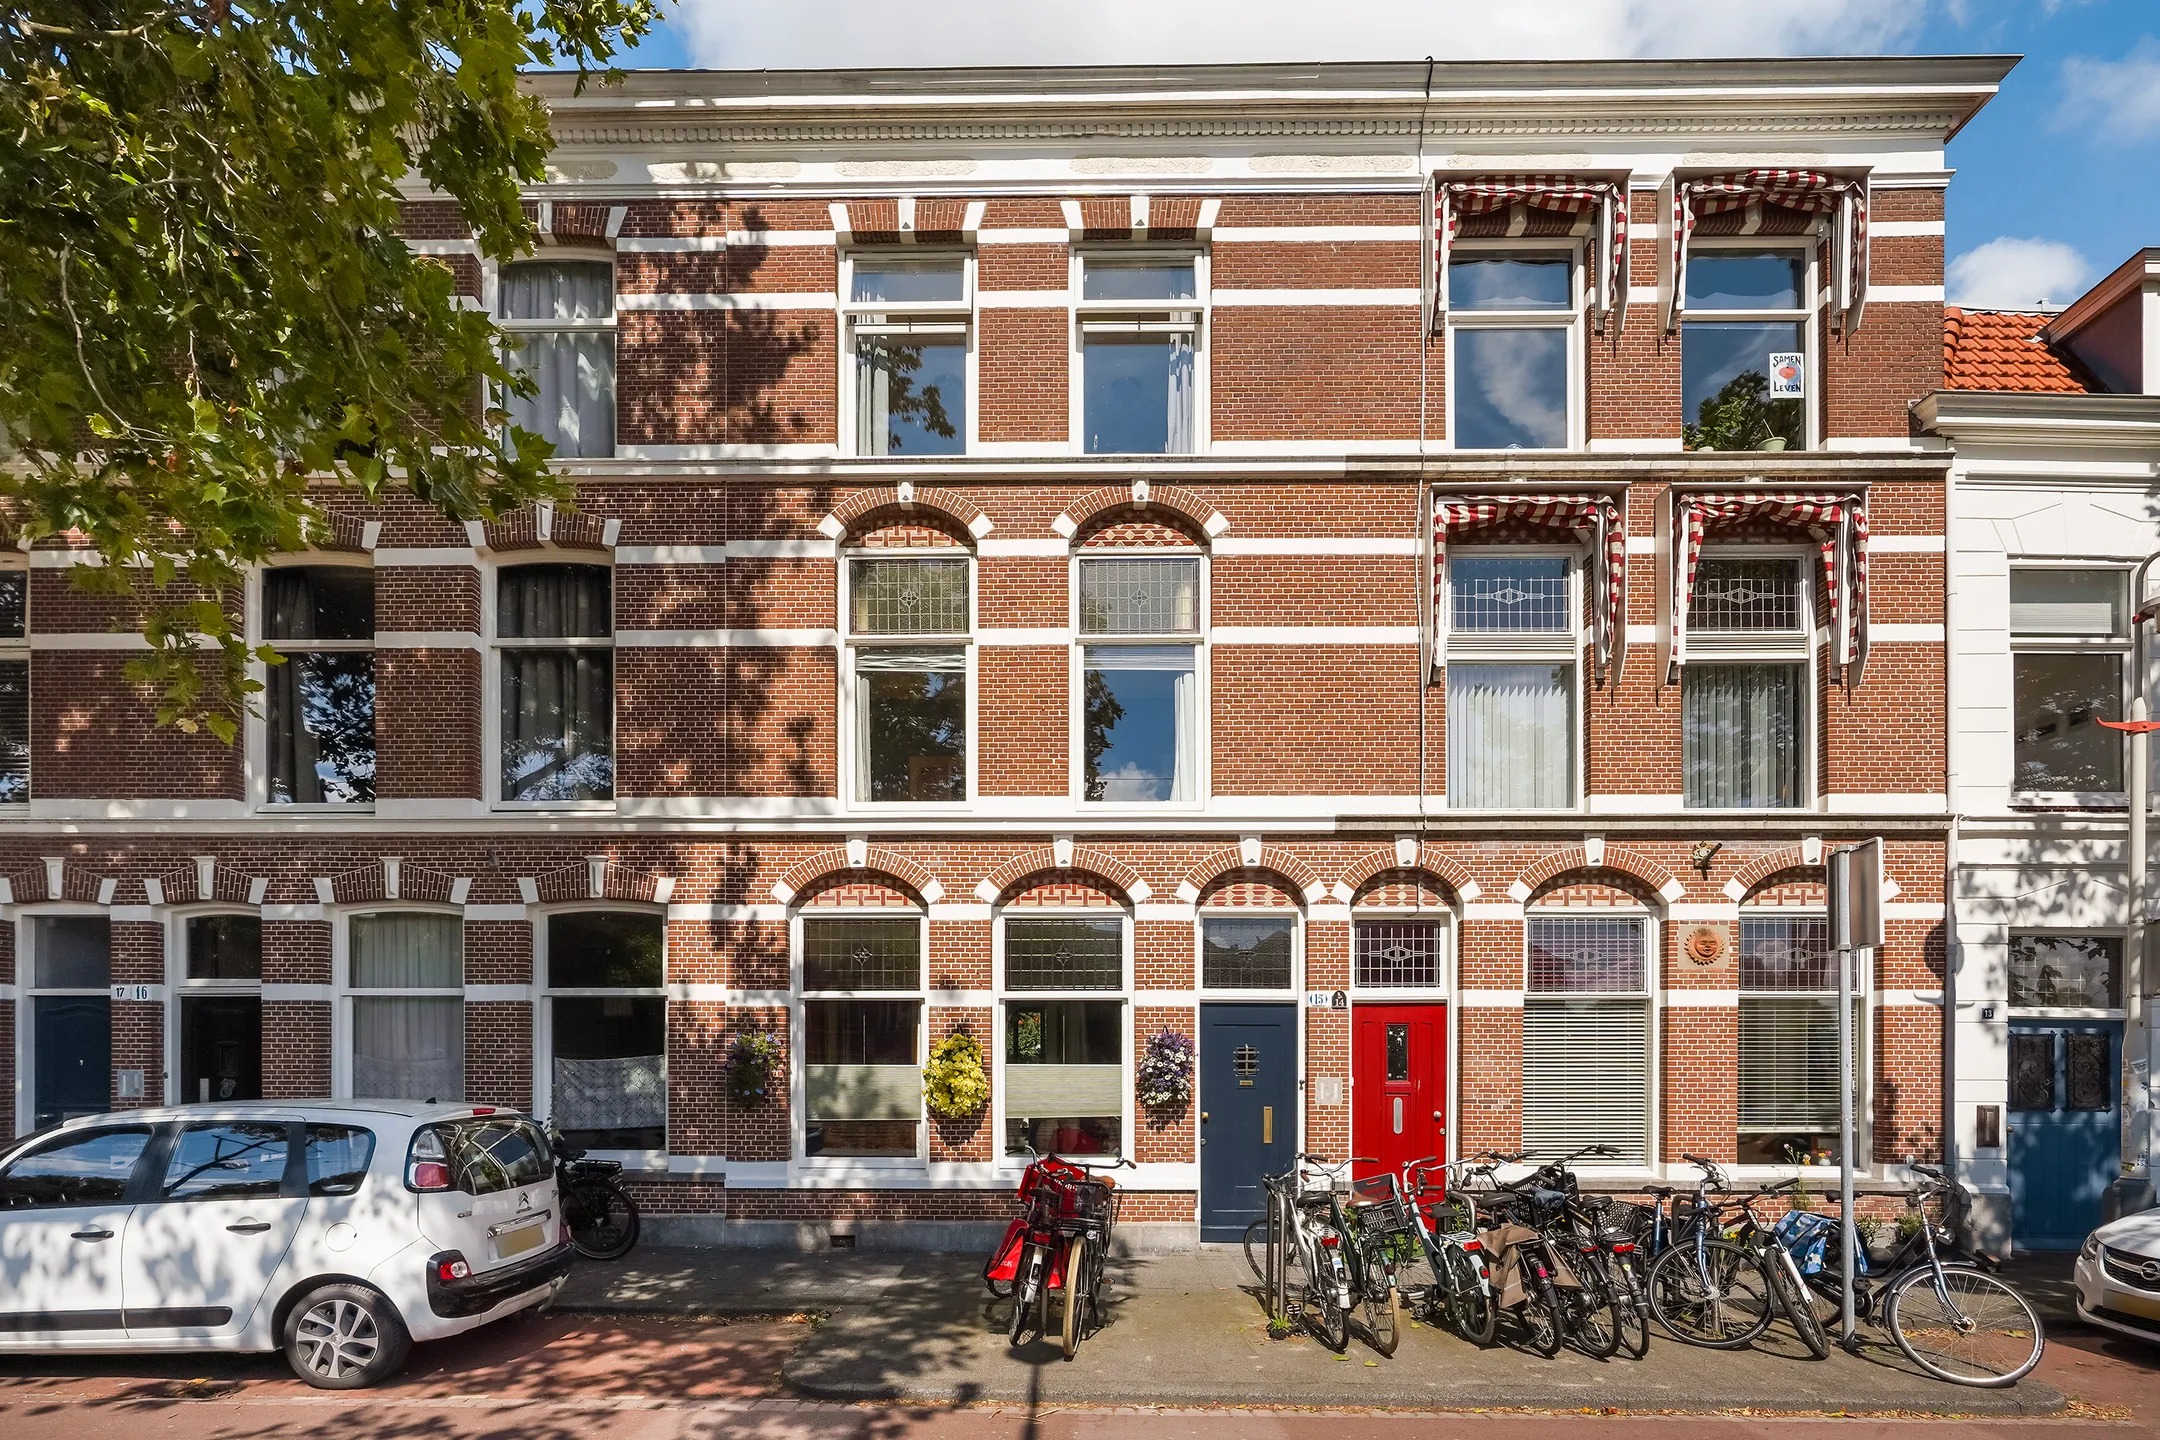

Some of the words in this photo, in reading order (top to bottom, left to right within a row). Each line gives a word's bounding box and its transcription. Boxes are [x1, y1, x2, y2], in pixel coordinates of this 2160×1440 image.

[1773, 355, 1801, 367] SAMEN
[1773, 380, 1801, 392] LEVEN
[116, 987, 125, 998] 17
[136, 985, 148, 1000] 16
[1314, 993, 1324, 1004] 15
[1335, 998, 1345, 1007] 14
[1984, 1009, 1993, 1018] 13
